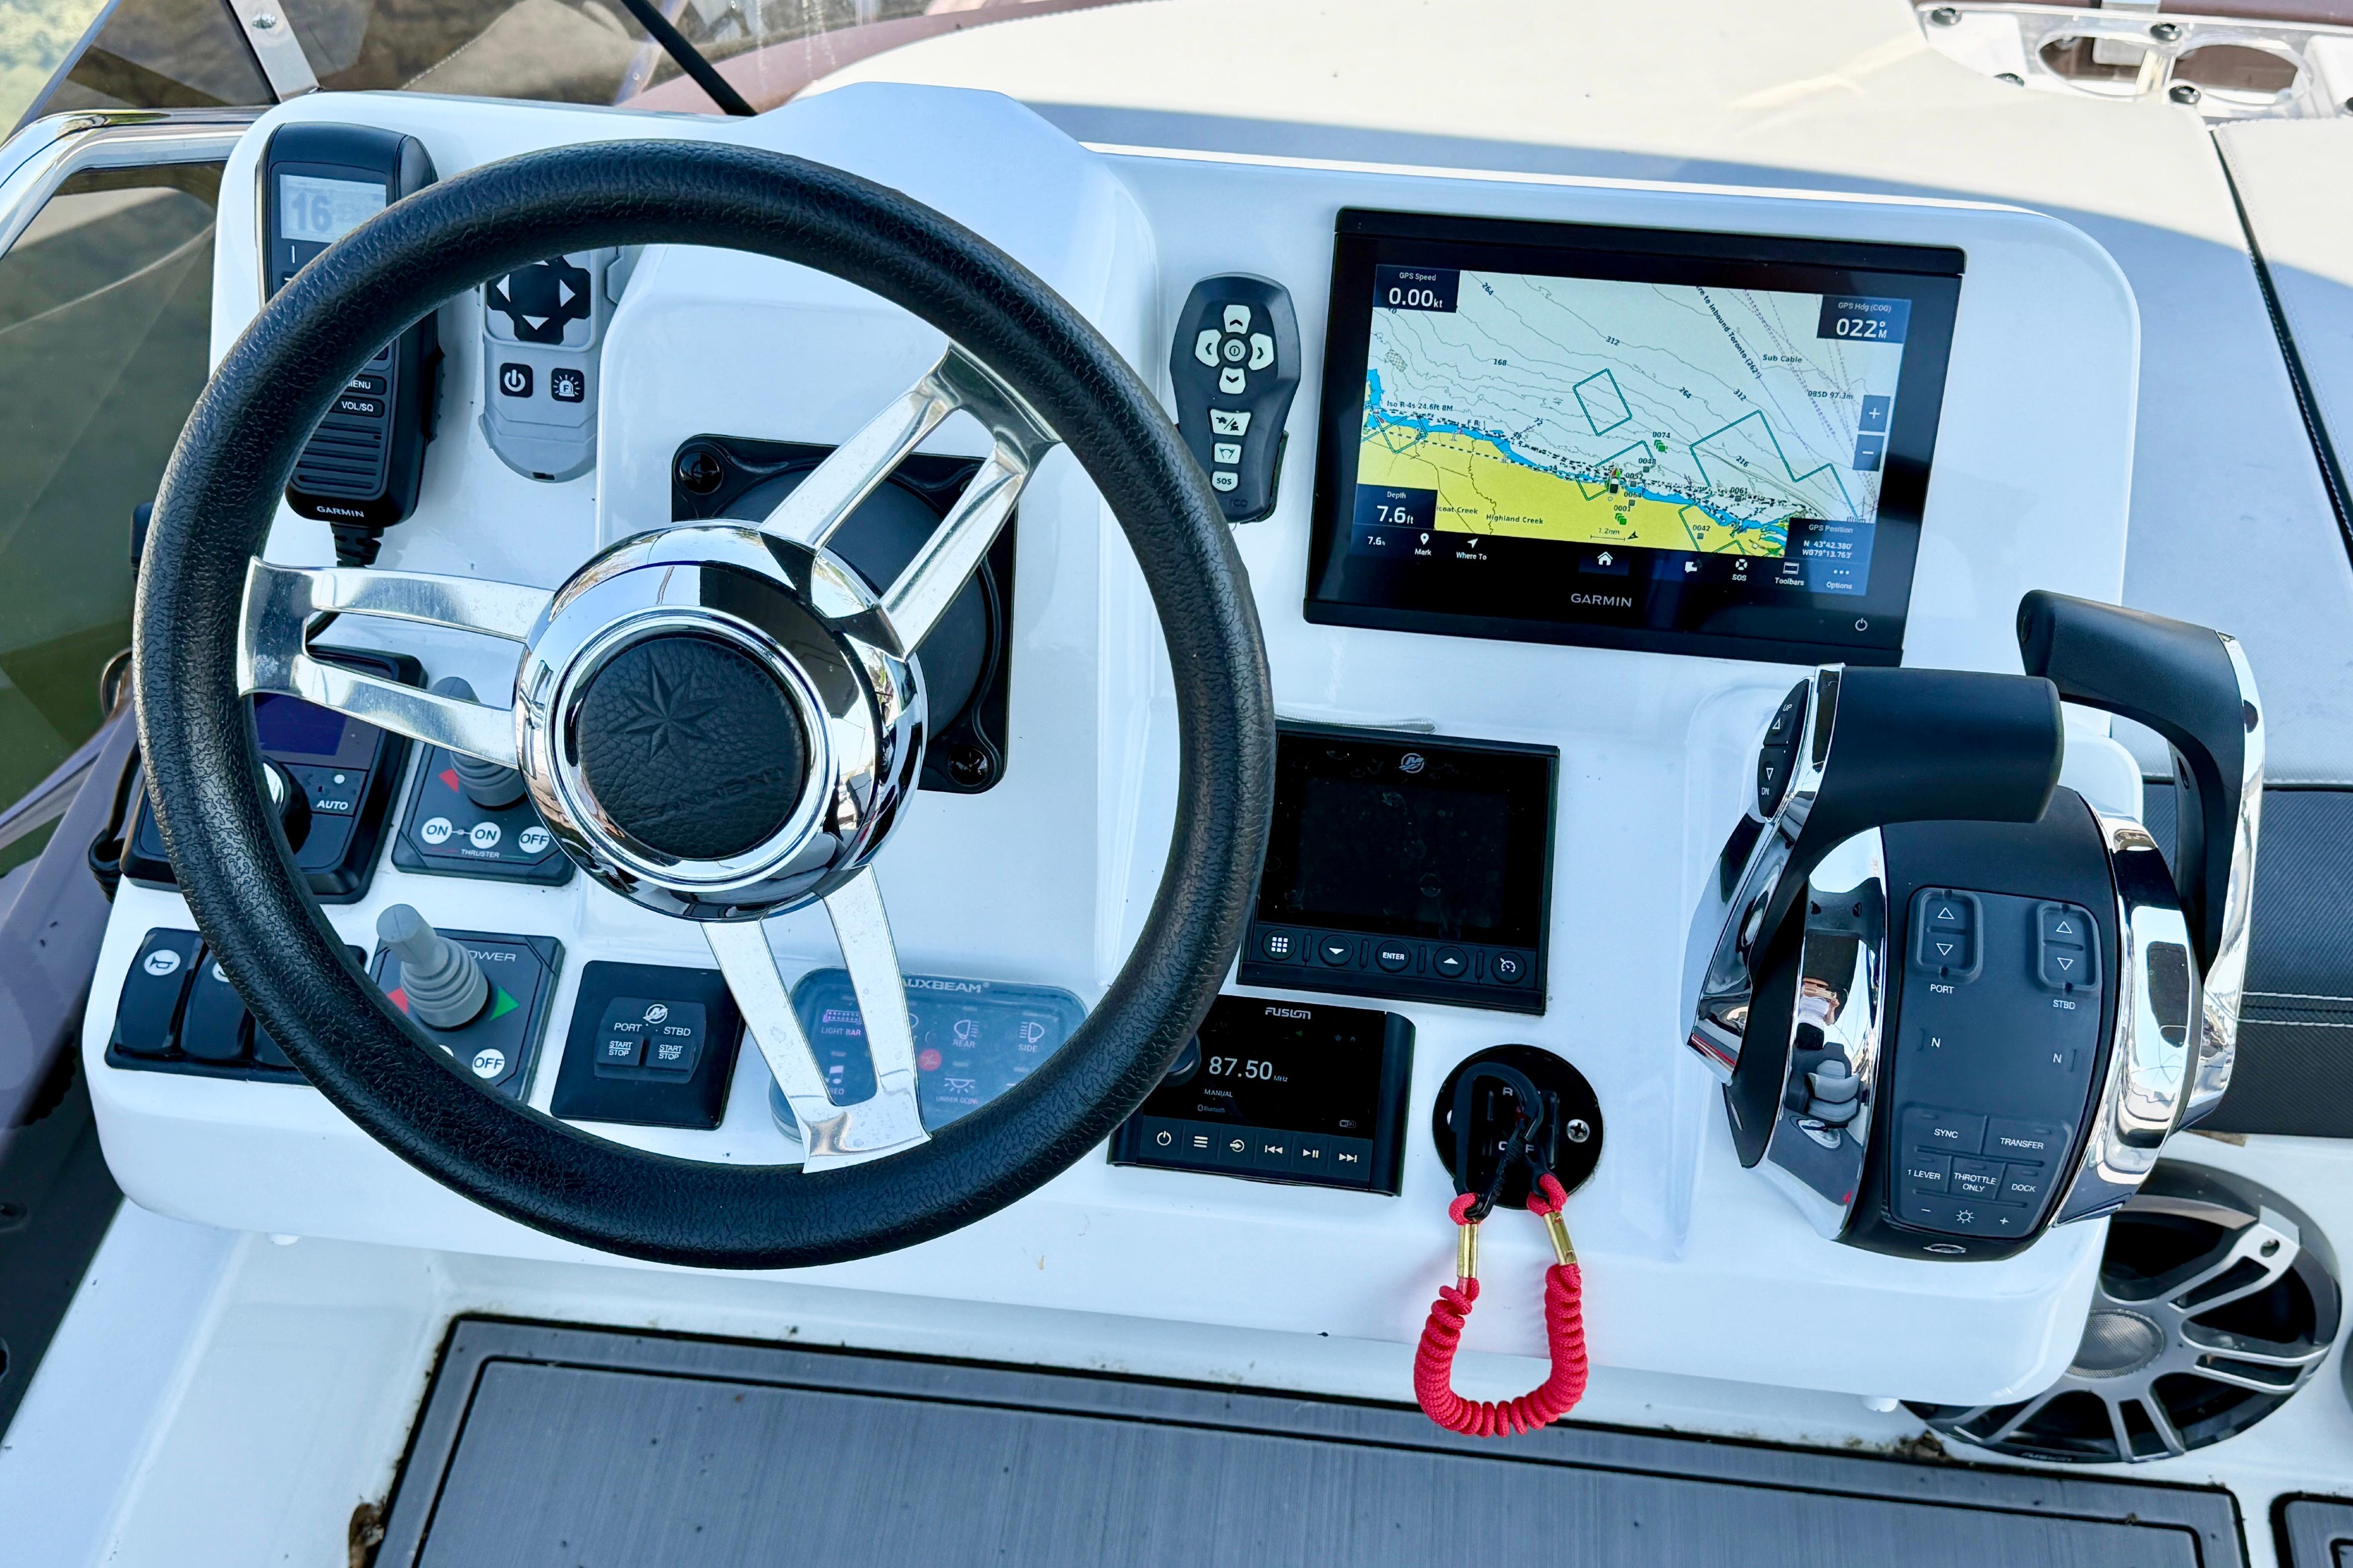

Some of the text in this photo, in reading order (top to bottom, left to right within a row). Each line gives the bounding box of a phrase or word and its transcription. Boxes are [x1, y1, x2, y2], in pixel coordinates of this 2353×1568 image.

[292, 190, 332, 232] 16
[1415, 273, 1436, 282] Speed
[1482, 283, 1494, 295] 264
[1855, 303, 1869, 312] Hdg
[1870, 304, 1891, 313] (COG)
[1704, 295, 1711, 304] to
[1709, 303, 1731, 332] Inbound
[1729, 332, 1747, 358] Toronto
[1606, 336, 1620, 346] 312
[1679, 387, 1691, 398] 264
[1734, 389, 1746, 401] 312
[341, 401, 374, 412] VOL/SQ
[1534, 417, 1542, 426] 72
[1736, 455, 1749, 467] 216
[1387, 491, 1406, 499] Depth
[317, 505, 364, 517] GARMIN
[1486, 513, 1520, 522] Highland
[1456, 551, 1476, 560] Where
[1775, 577, 1804, 586] Toolbars
[1826, 581, 1852, 589] Options
[1571, 593, 1632, 607] GARMIN
[1761, 787, 1769, 796] DN
[317, 800, 348, 810] AUTO
[426, 825, 497, 840] ON ON
[519, 833, 549, 845] OFF
[461, 849, 500, 858] THRUSTER
[468, 950, 516, 962] OWER
[1383, 952, 1405, 960] ENTER
[1931, 984, 1954, 994] PORT
[2052, 999, 2075, 1010] STBD
[1265, 1007, 1311, 1019] FUSION
[614, 1022, 643, 1032] PORT
[663, 1027, 691, 1036] STBD
[953, 1039, 975, 1048] REAR
[1931, 1037, 1941, 1048] N
[1018, 1044, 1038, 1053] SIDE
[474, 1057, 504, 1069] OFF
[2052, 1053, 2062, 1063] N
[1209, 1056, 1273, 1079] 87.50
[1204, 1088, 1233, 1097] MANUAL
[1934, 1128, 1958, 1138] SYNC
[1498, 1141, 1535, 1154] OF
[2000, 1137, 2044, 1149] TRANSFER
[1914, 1170, 1941, 1180] LEVER
[1954, 1172, 1997, 1184] THROTTLE
[1962, 1183, 1985, 1192] ONLY
[2011, 1183, 2036, 1193] DOCK
